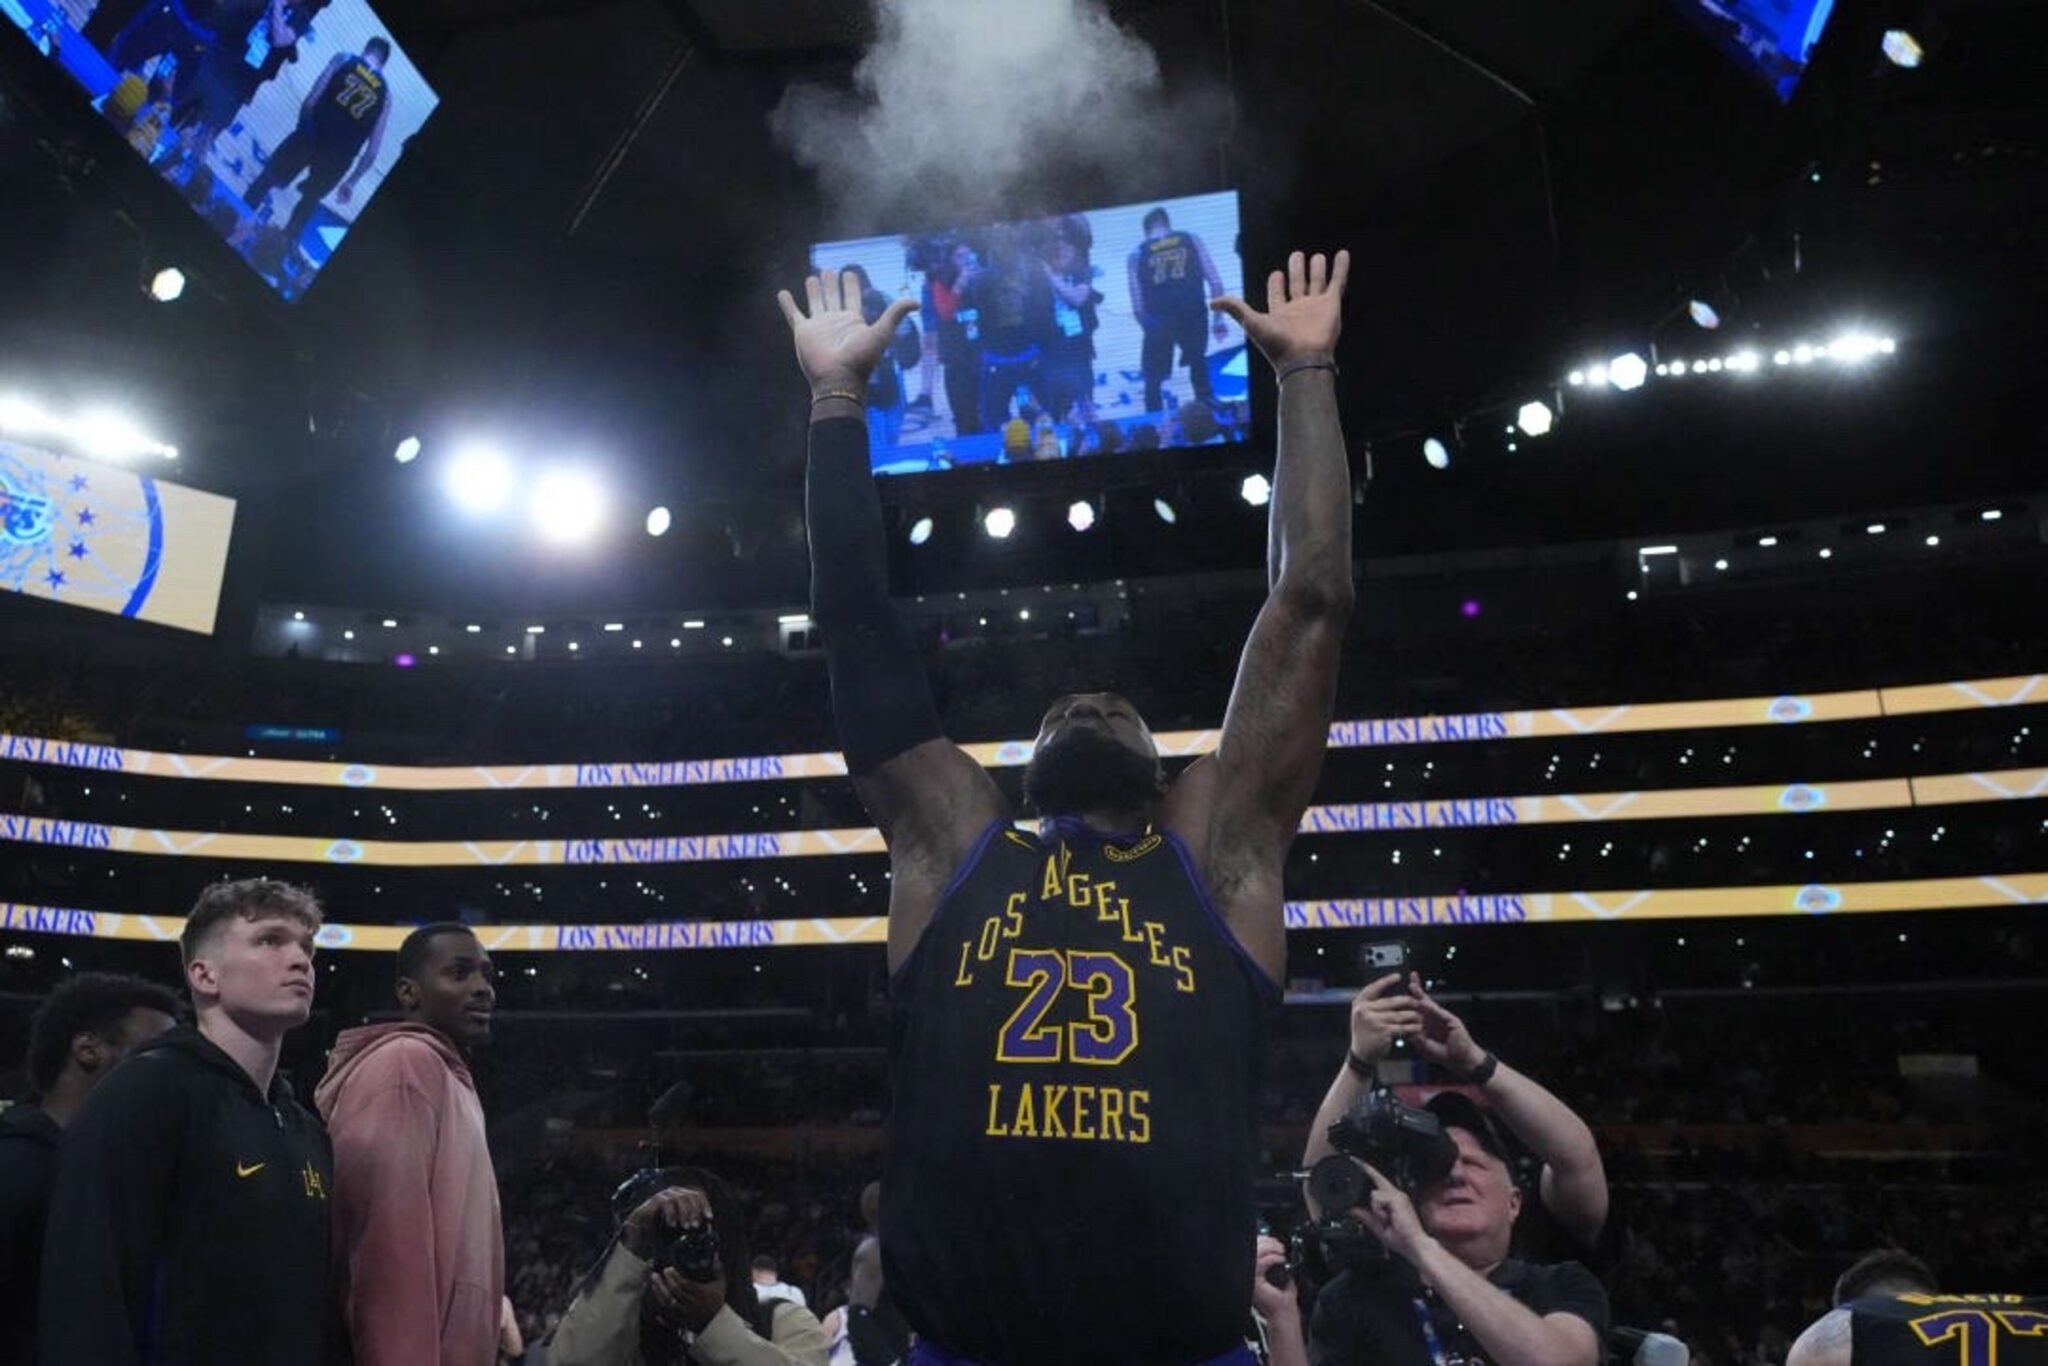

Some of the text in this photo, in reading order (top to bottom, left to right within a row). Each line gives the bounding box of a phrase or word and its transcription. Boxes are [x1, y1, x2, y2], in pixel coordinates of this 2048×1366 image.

[1328, 714, 1507, 746] GELES LAKERS
[38, 739, 124, 770] LAKERS
[576, 756, 783, 788] LOS ANGELES LAKERS
[1311, 798, 1517, 832] ANGELES LAKERS
[21, 817, 111, 848] LAKERS
[565, 833, 780, 864] LOS ANGELES LAKERS
[4, 903, 95, 935] LAKERS
[1316, 897, 1422, 927] ANGELES
[1426, 894, 1526, 925] LAKERS
[558, 920, 774, 949] LOS ANGELES LAKERS
[955, 892, 1027, 986] LOS
[996, 948, 1139, 1065] 23
[986, 1083, 1151, 1143] LAKERS
